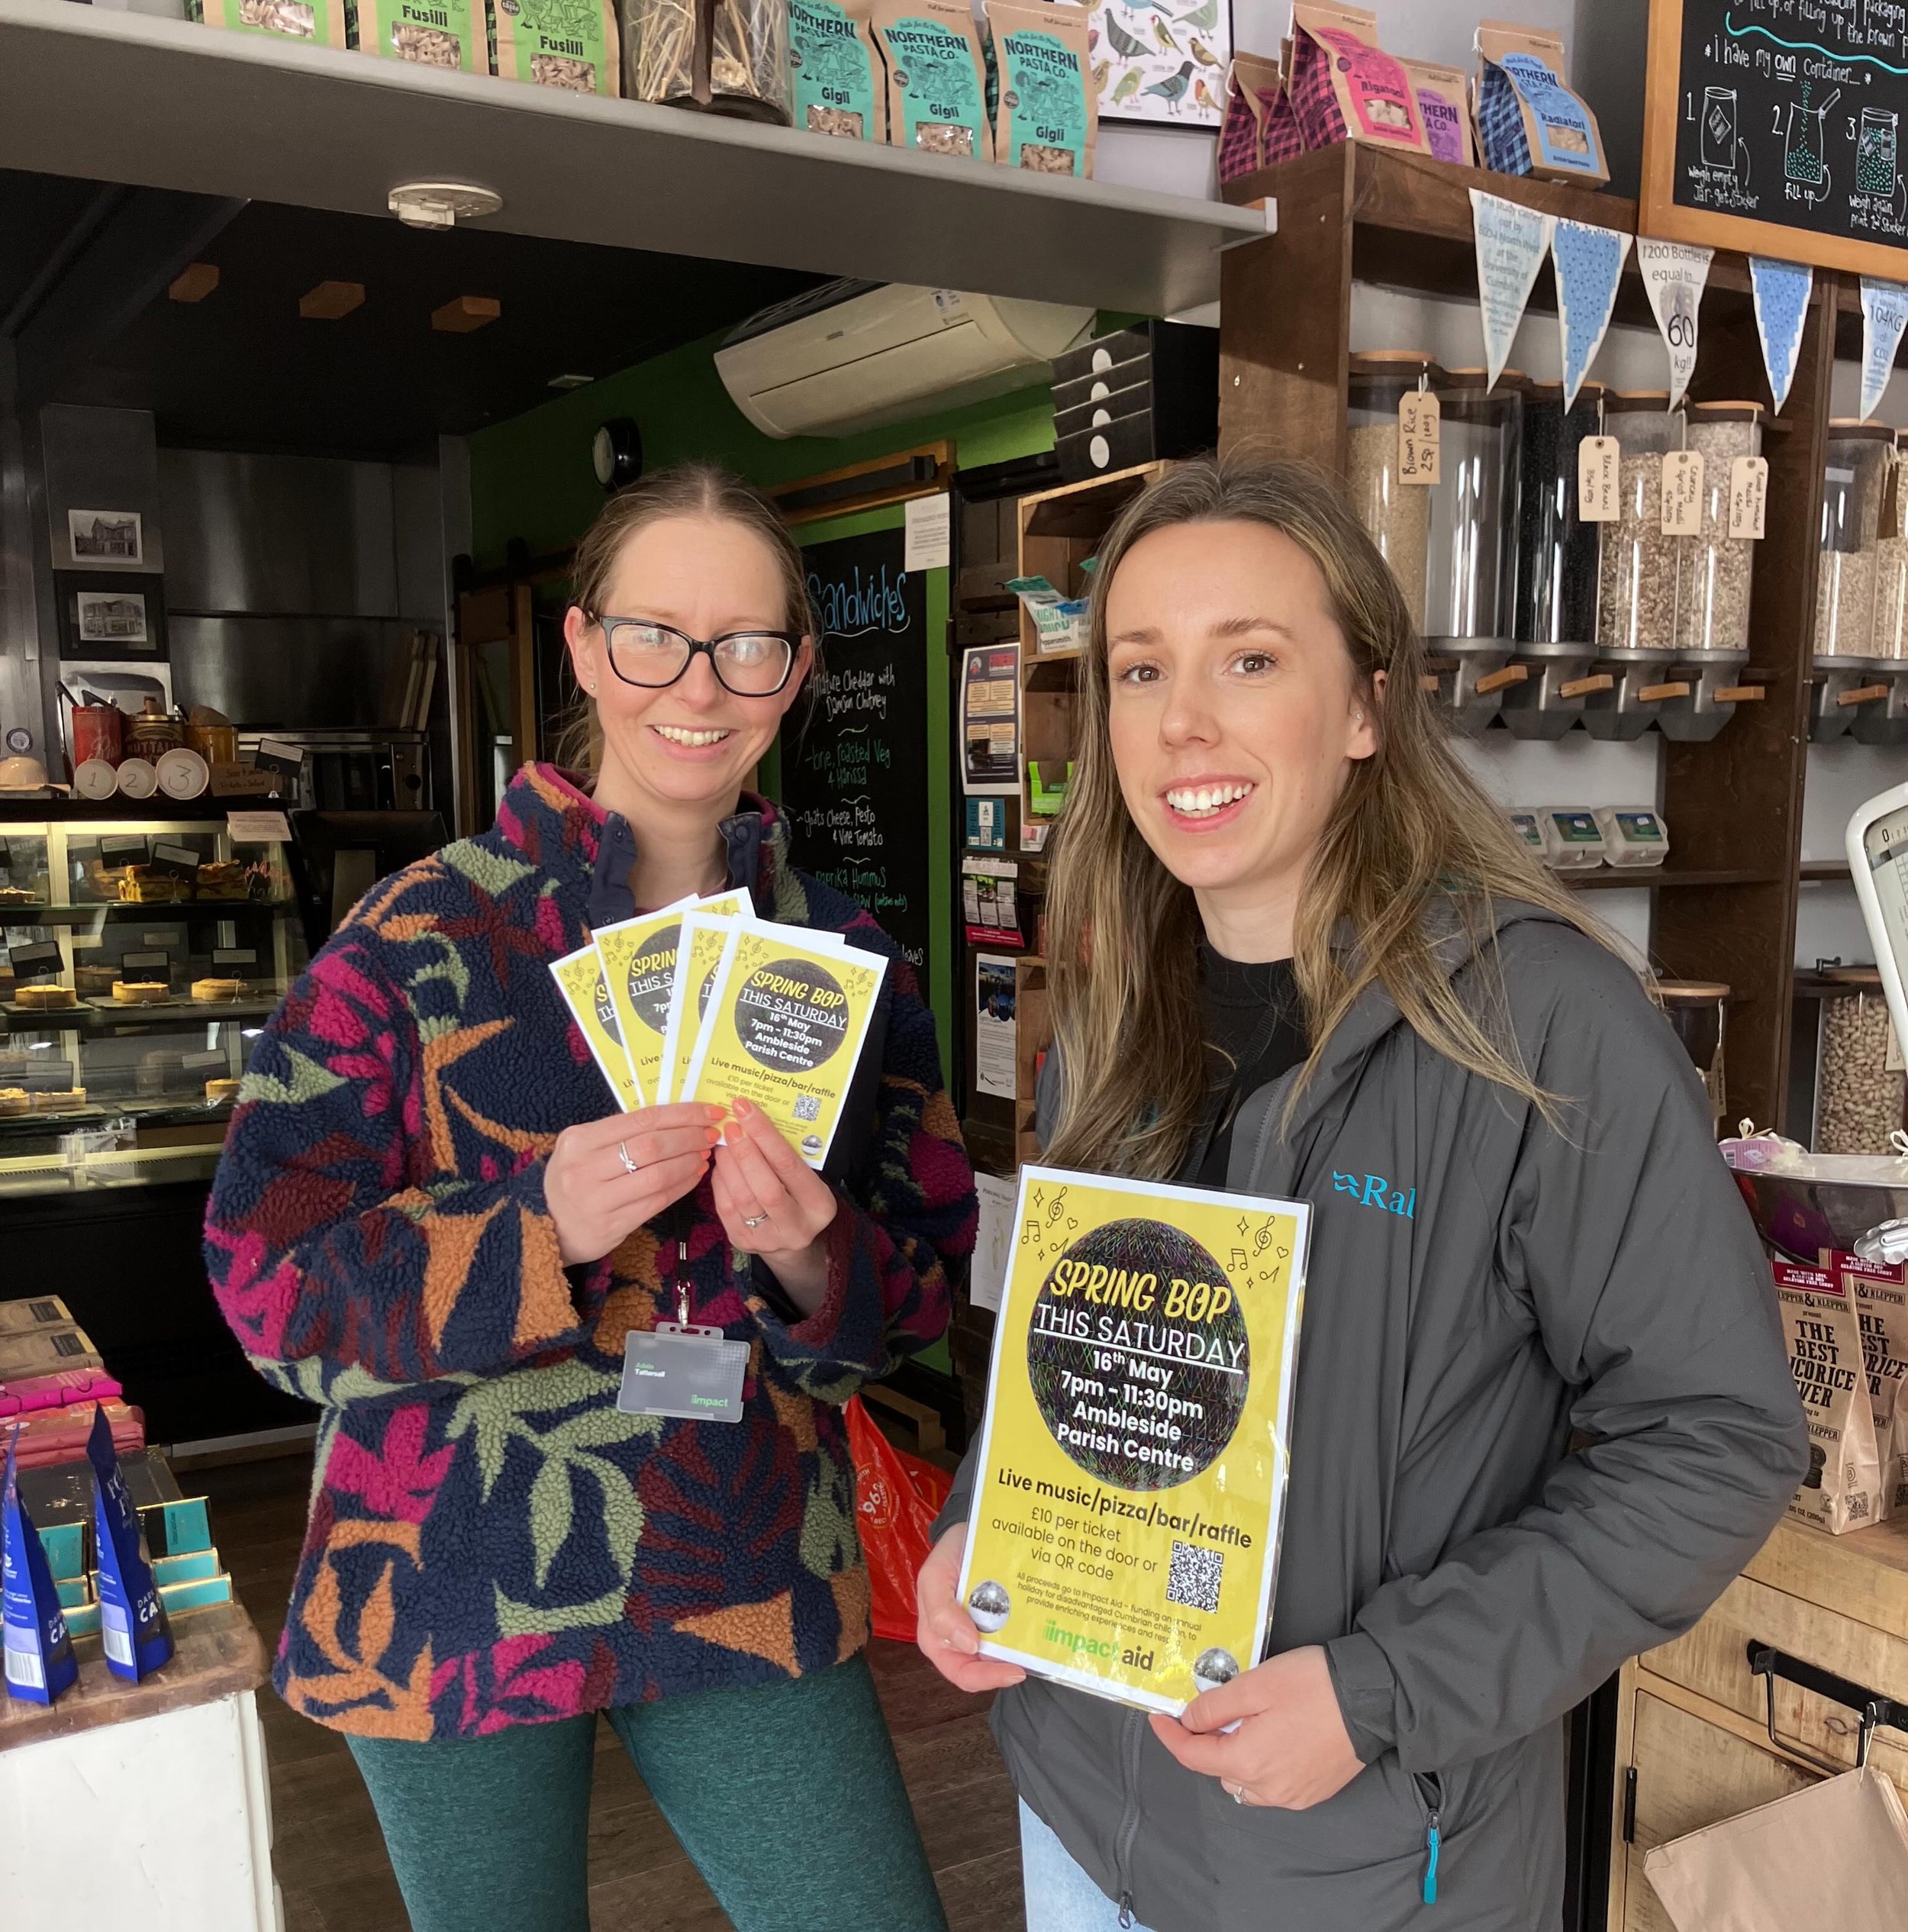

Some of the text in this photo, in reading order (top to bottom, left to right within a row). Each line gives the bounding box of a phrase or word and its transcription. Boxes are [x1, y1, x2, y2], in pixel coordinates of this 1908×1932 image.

[402, 5, 448, 27] Fusilli
[1798, 1, 1826, 33] filling
[1832, 13, 1844, 39] up
[1848, 27, 1863, 44] the
[1868, 18, 1895, 47] brown
[540, 35, 584, 56] Fusilli
[885, 29, 969, 53] NORTHERN
[903, 44, 939, 58] PASTA
[1004, 38, 1078, 72] NORTHERN
[1020, 57, 1051, 74] PASTA
[1724, 38, 1797, 78] have my own
[821, 87, 850, 105] Gigli
[1362, 81, 1405, 98] Rigatoni
[930, 103, 959, 119] Gigli
[1541, 113, 1585, 131] Radiatori
[1036, 126, 1064, 143] Gigli
[1642, 245, 1669, 259] 1200
[1671, 246, 1701, 263] Bottles
[1652, 267, 1683, 284] equal
[1668, 314, 1694, 348] 60
[1402, 408, 1417, 475] Brown Rice
[807, 564, 906, 648] Sandwiches
[843, 663, 895, 692] Cheddar with
[856, 689, 887, 720] Chutney
[874, 739, 891, 769] Veg
[89, 772, 97, 788] 1
[125, 773, 138, 788] 2
[168, 765, 192, 792] 3
[855, 805, 875, 827] Pesto
[839, 827, 883, 847] Vine Tomato
[1882, 828, 1889, 843] 0
[852, 866, 886, 889] Hummus
[631, 948, 678, 978] SPRIN
[629, 976, 661, 994] THIS
[751, 970, 845, 1009] SPRING BOP
[743, 988, 847, 1028] THIS SATURDAY
[751, 1018, 823, 1047] 7pm 11:30pm
[769, 1011, 811, 1033] 16th May
[745, 1041, 814, 1068] Parish Centre
[755, 1032, 811, 1055] Ambleside
[641, 1056, 660, 1066] Live
[711, 1056, 836, 1099] Live music/pizza/bar/raffle
[727, 1075, 774, 1093] £10 per ticket
[706, 1078, 791, 1106] available on the door or
[1050, 1259, 1232, 1324] SPRING BOP
[1778, 1291, 1848, 1312] LEPPER & KLEPPER
[1858, 1283, 1903, 1303] & KLEPPER
[1037, 1303, 1246, 1369] THIS SATURDAY
[1796, 1320, 1835, 1344] THE
[1858, 1314, 1885, 1336] HE
[1794, 1338, 1839, 1365] BEST
[1860, 1334, 1890, 1356] EST
[1093, 1350, 1174, 1389] 16th May
[1061, 1370, 1204, 1420] 7pm 11:30pm
[1072, 1400, 1182, 1441] Ambleside
[1057, 1422, 1194, 1472] Parish Centre
[998, 1468, 1252, 1549] Live music/pizza/bar/raffle
[1031, 1507, 1121, 1543] £10 per ticket
[992, 1517, 1158, 1573] available on the door or
[1031, 1547, 1114, 1581] via QR code
[1017, 1572, 1172, 1623] All proceeds go to Impact Aid funding an
[1017, 1582, 1197, 1641] holiday for disadvantaged Cumbrian to
[1027, 1595, 1054, 1610] provide
[1055, 1605, 1090, 1621] enriching
[1137, 1627, 1153, 1638] and
[1122, 1645, 1155, 1672] aid
